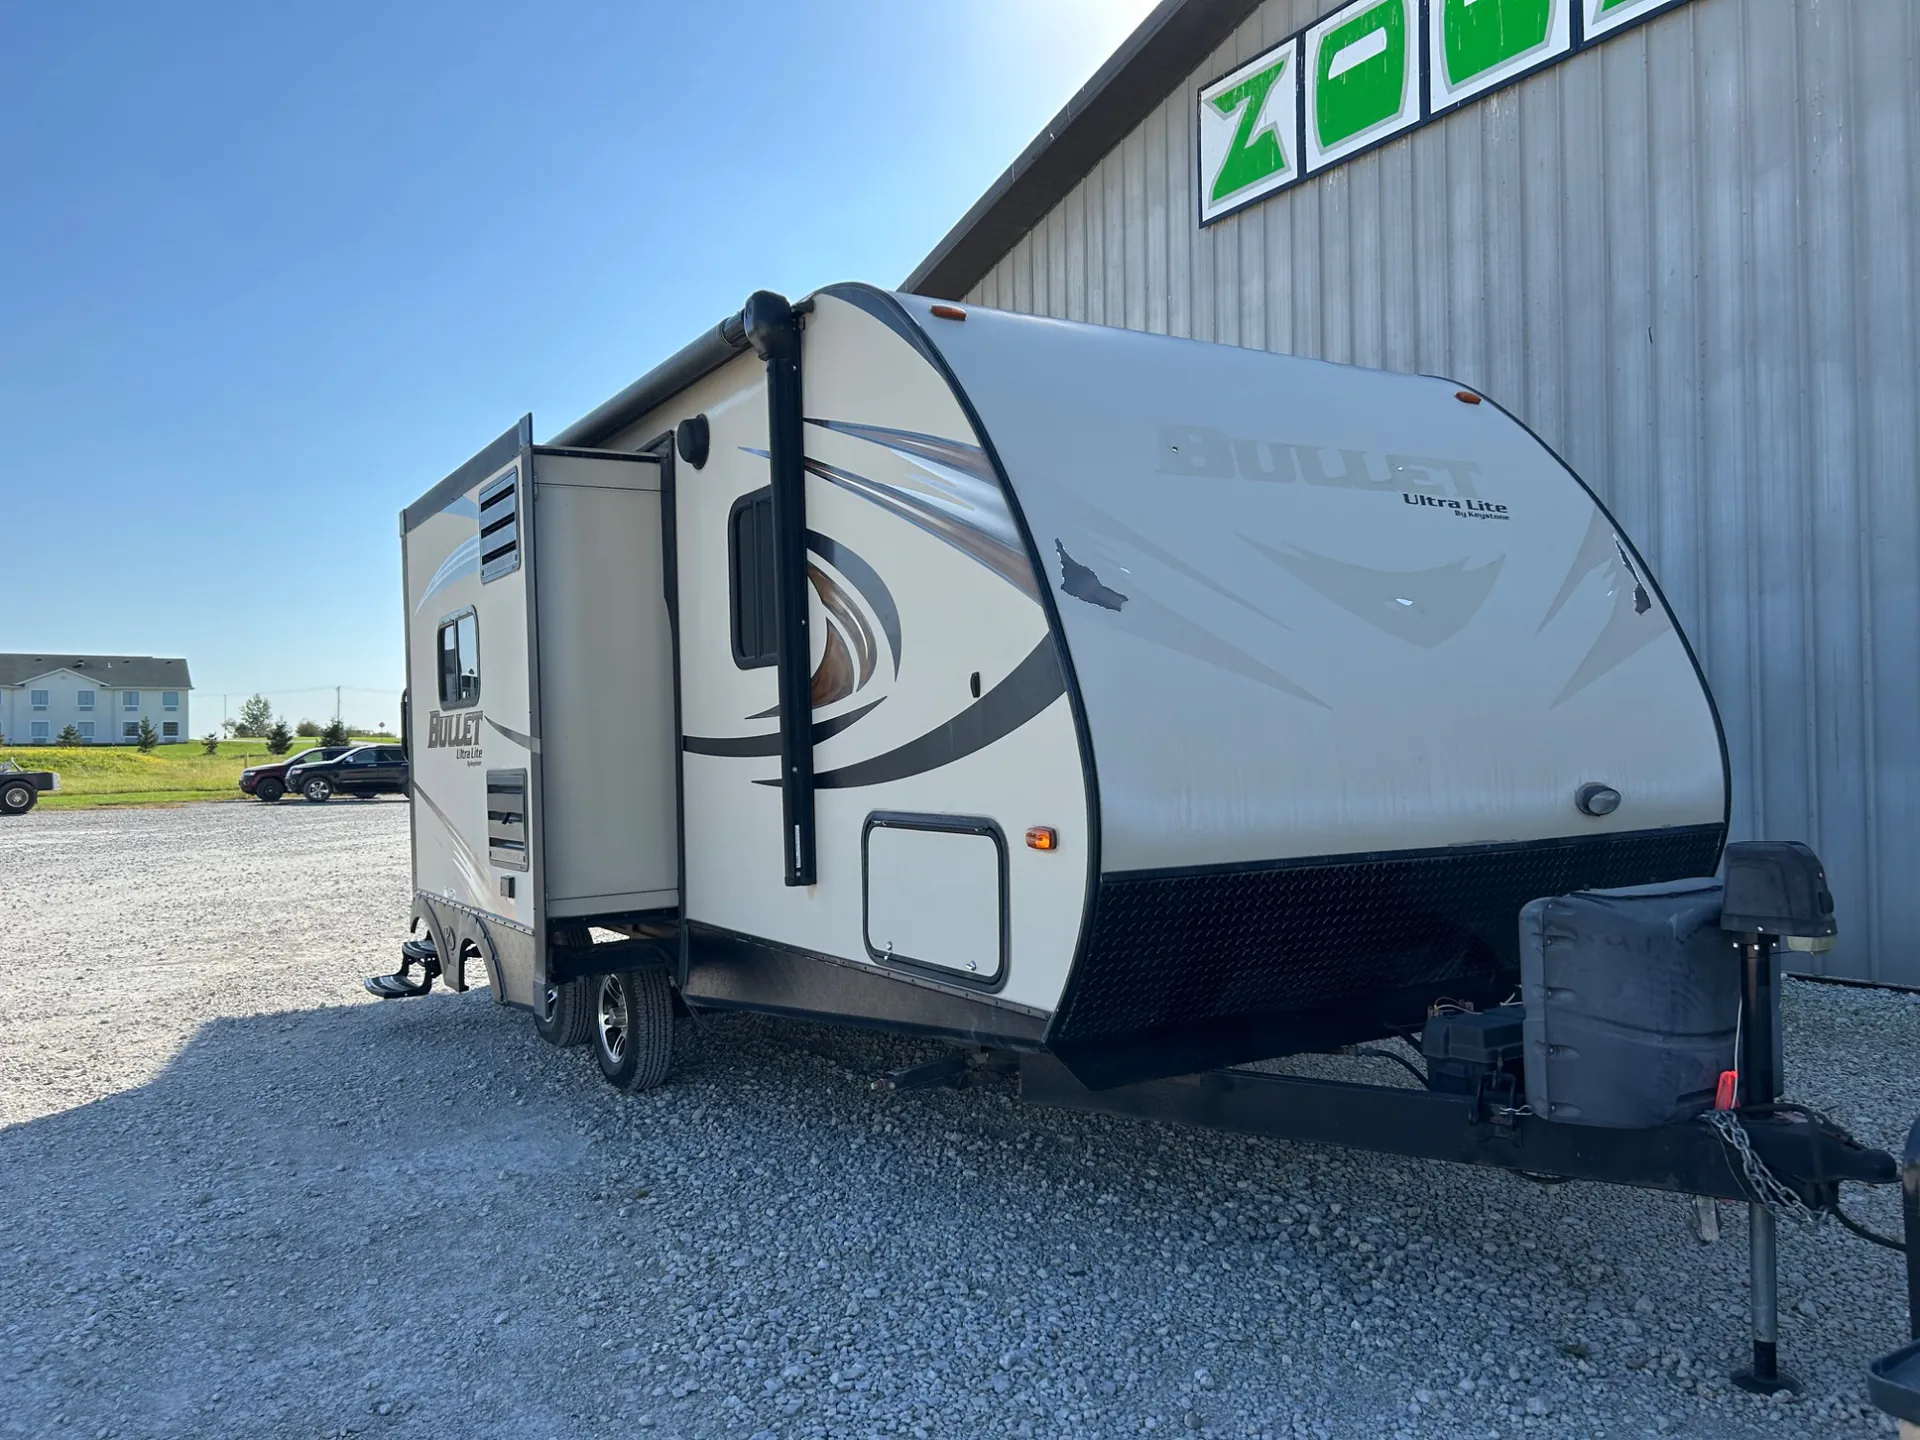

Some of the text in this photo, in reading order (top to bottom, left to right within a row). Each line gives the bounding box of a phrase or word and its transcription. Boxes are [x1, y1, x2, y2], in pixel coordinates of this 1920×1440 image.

[1155, 425, 1482, 498] BULLET
[1403, 493, 1508, 514] Ultra Lite
[1454, 509, 1510, 520] By Keystone
[427, 710, 484, 748] BULLET
[471, 747, 483, 758] Lite
